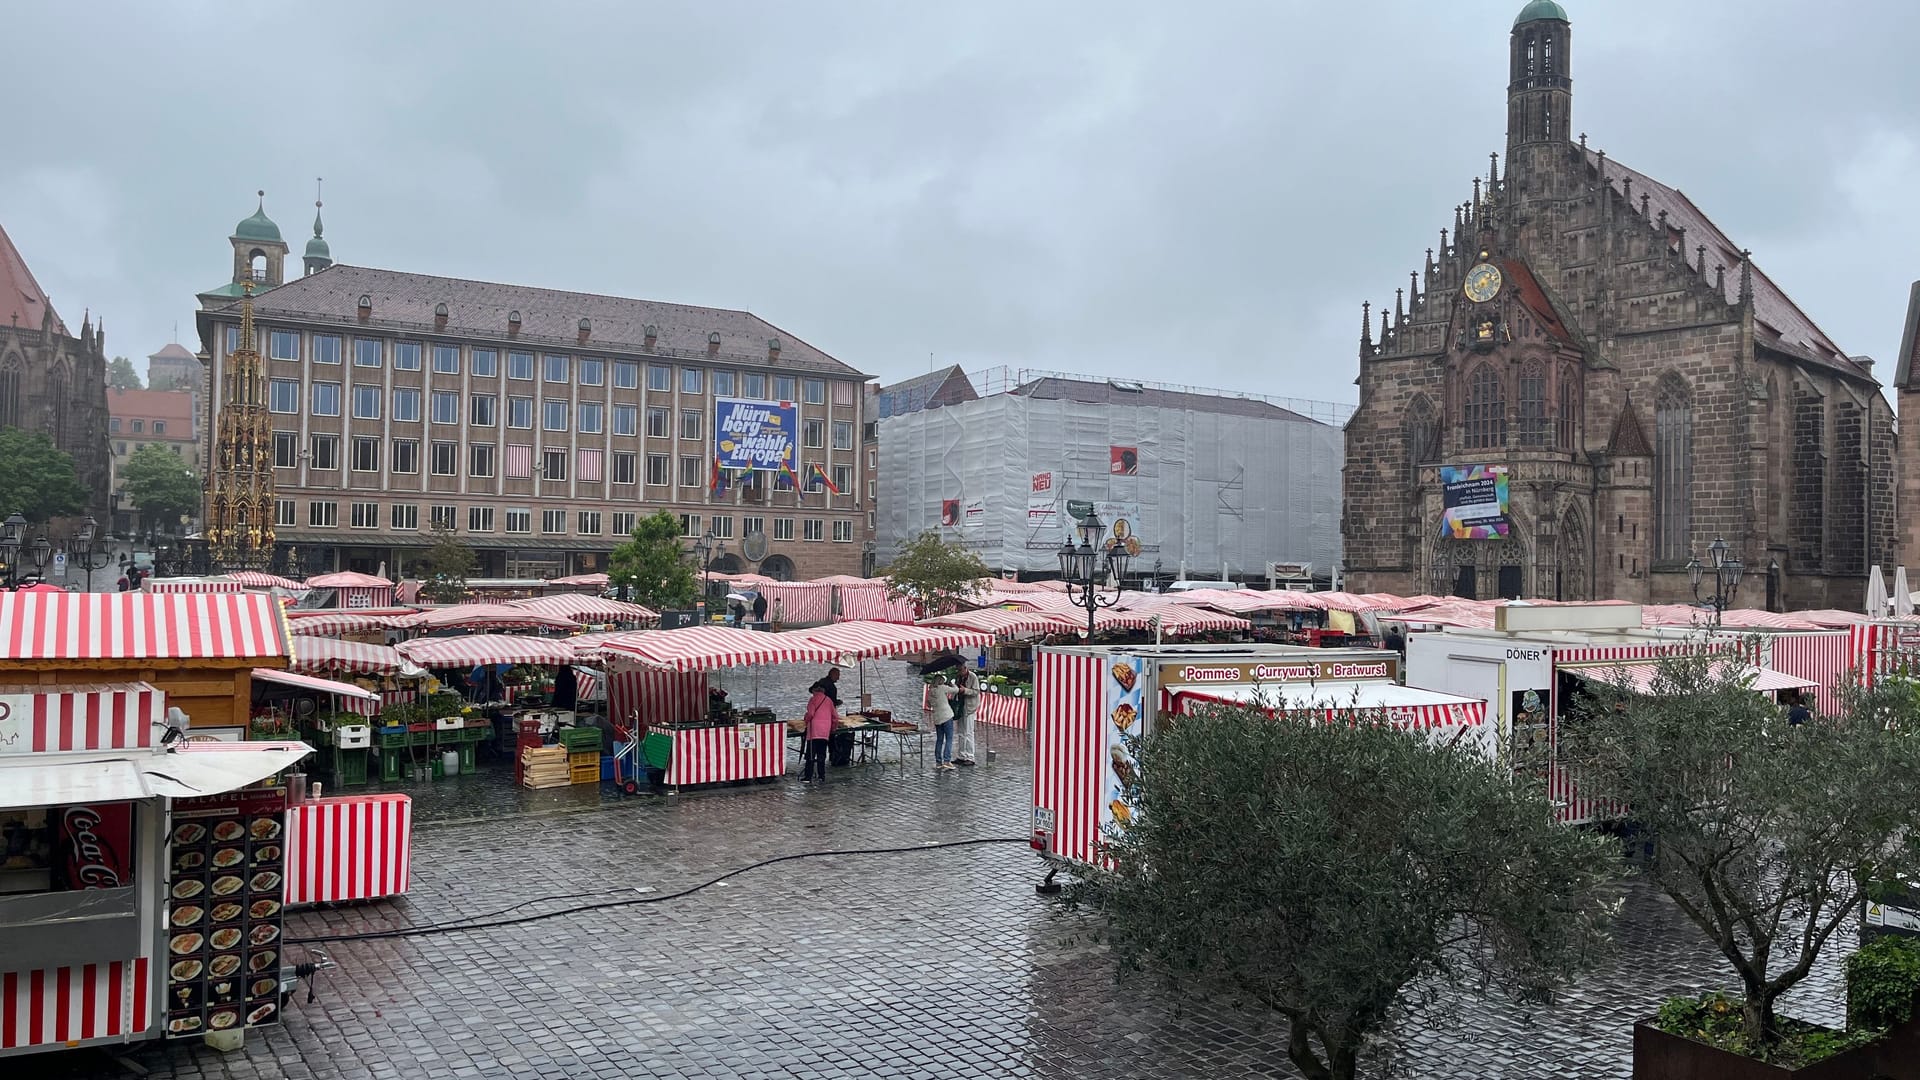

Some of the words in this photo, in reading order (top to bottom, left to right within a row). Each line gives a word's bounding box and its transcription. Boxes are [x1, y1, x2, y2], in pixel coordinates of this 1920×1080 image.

[731, 404, 770, 422] Nürn
[722, 416, 761, 437] berg
[742, 434, 787, 450] wählt
[731, 444, 784, 465] Europa
[1033, 479, 1051, 491] NEU
[1506, 648, 1540, 660] DÖNER
[1185, 666, 1240, 681] Pommes
[1256, 664, 1320, 682] Currywurst
[1333, 664, 1386, 678] Bratwurst
[1391, 712, 1414, 721] Curry
